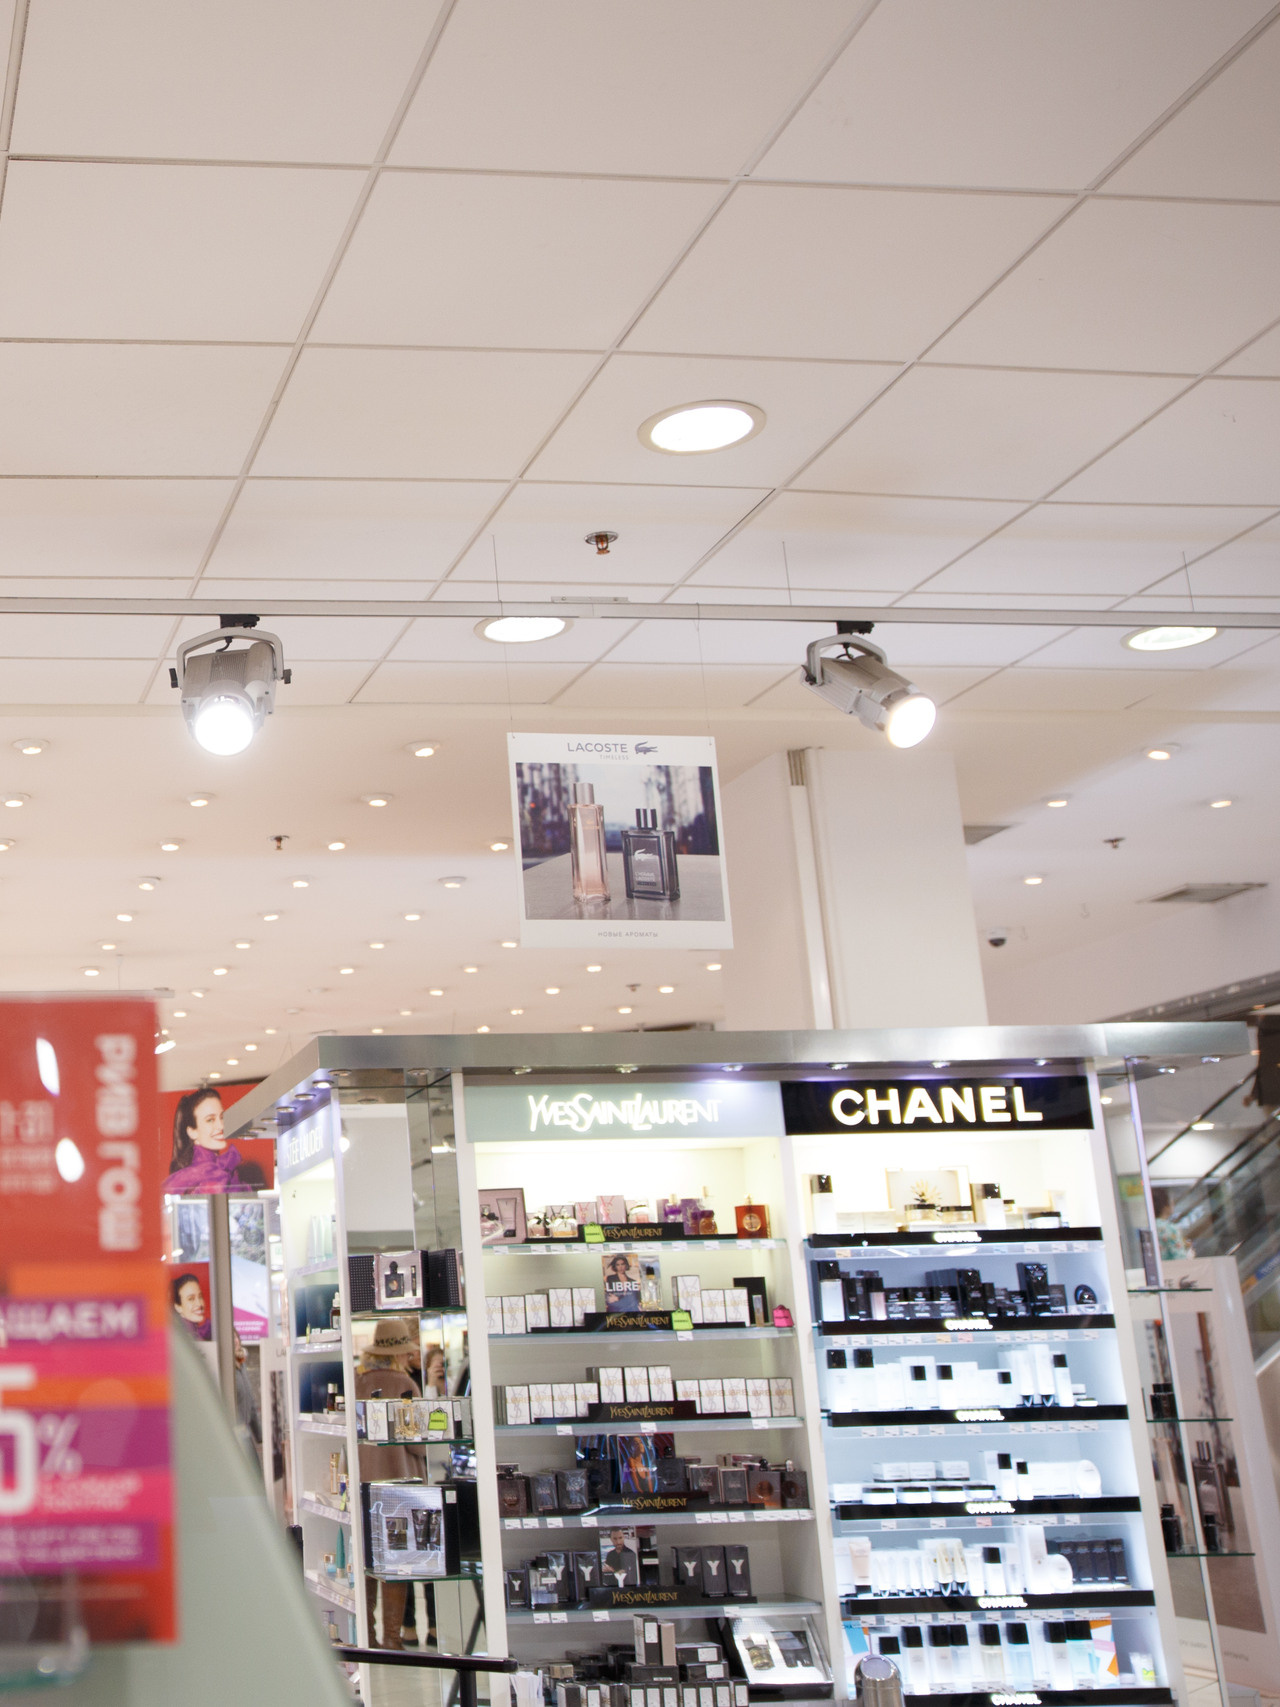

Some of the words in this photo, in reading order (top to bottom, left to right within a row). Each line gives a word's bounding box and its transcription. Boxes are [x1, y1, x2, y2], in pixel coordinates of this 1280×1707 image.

[567, 742, 628, 753] LACOSTE
[831, 1086, 1043, 1126] CHANEL
[606, 1281, 640, 1292] LIBRE
[552, 1565, 565, 1581] Y
[580, 1566, 593, 1581] Y
[683, 1561, 697, 1577] Y
[707, 1560, 720, 1576] Y
[731, 1559, 744, 1575] Y
[512, 1580, 521, 1591] Y
[614, 1573, 627, 1588] Y
